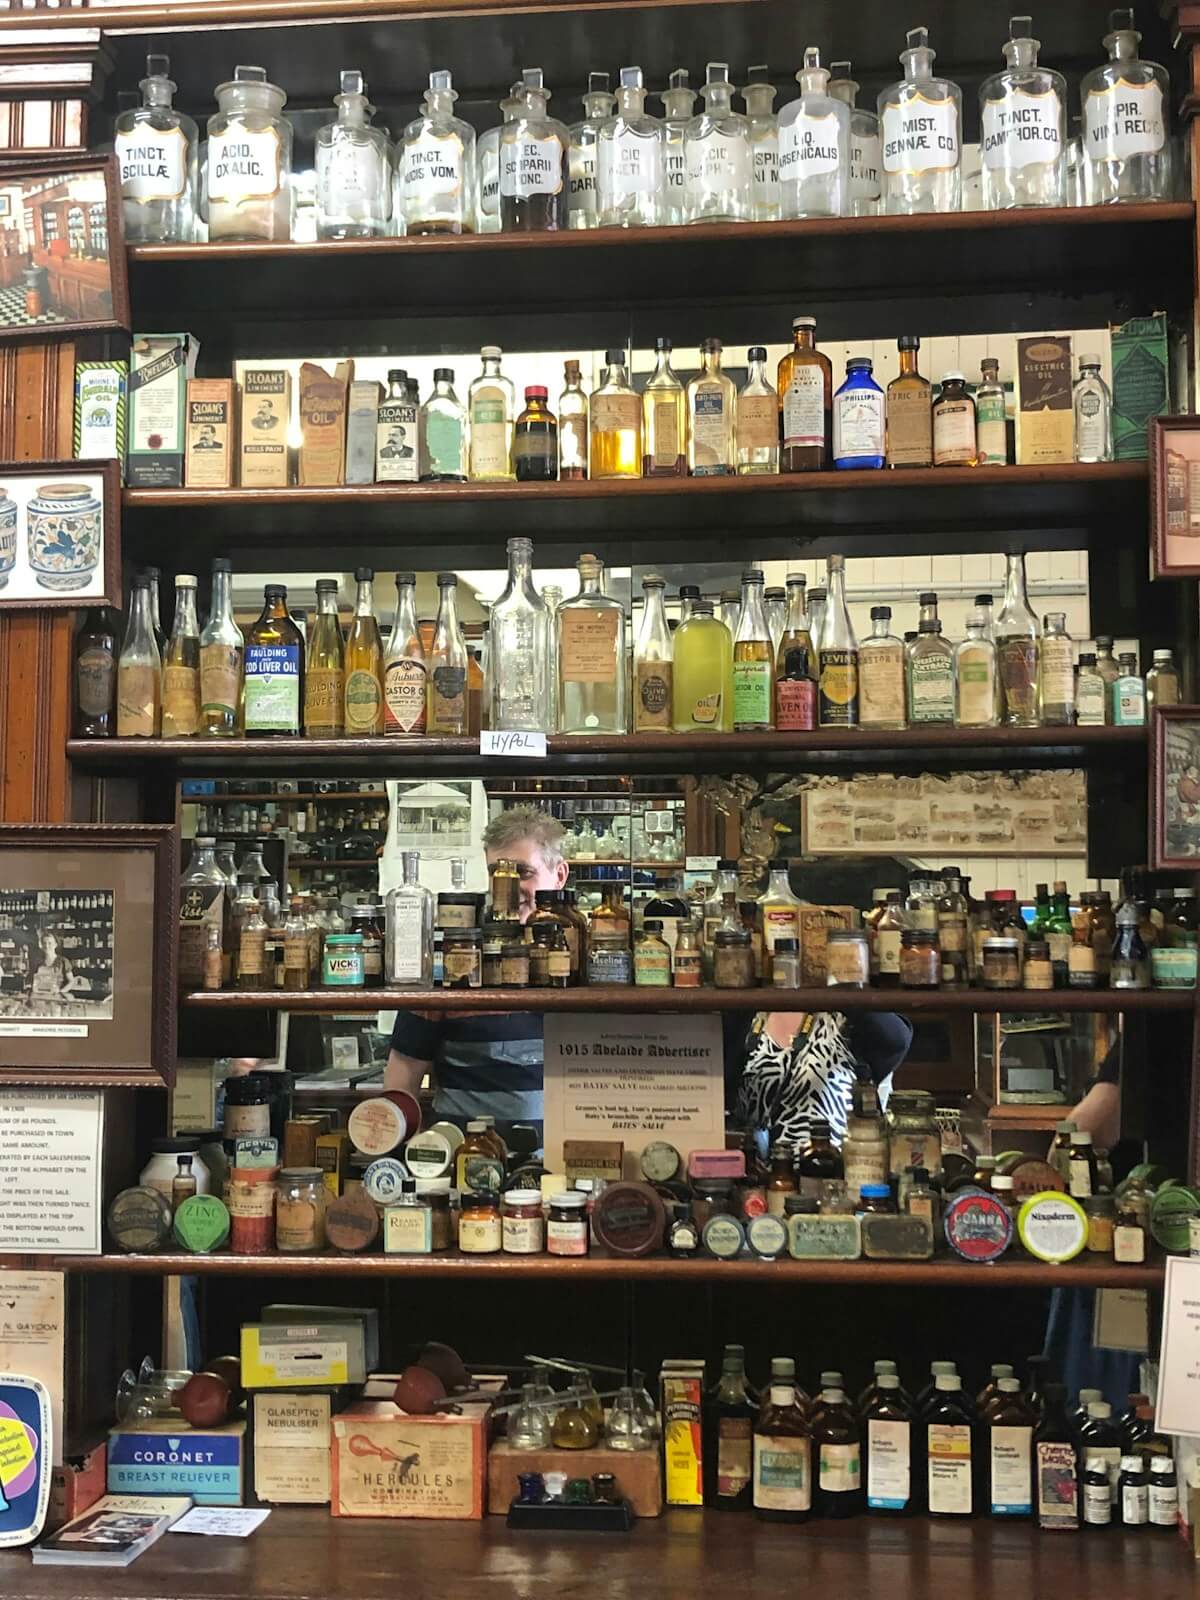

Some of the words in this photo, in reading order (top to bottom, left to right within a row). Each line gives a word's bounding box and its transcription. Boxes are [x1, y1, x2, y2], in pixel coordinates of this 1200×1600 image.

[902, 117, 937, 133] MIST.
[937, 135, 956, 151] CO.
[126, 147, 167, 161] TINCT.
[221, 145, 254, 158] ACID.
[216, 163, 263, 178] OXALIC.
[430, 166, 458, 180] VOM.
[1024, 362, 1065, 372] ELECTRIC
[247, 373, 284, 385] SLOAN'S
[1038, 371, 1053, 379] OIL
[192, 403, 224, 416] SLOAN'S
[378, 408, 414, 418] SLOAN'S
[311, 412, 331, 424] OIL
[250, 648, 288, 658] FAULDING
[258, 661, 282, 673] LIVER
[283, 661, 297, 672] OIL
[329, 958, 359, 972] VICKS
[559, 1043, 588, 1056] 1915
[593, 1042, 643, 1057] Adelaide
[648, 1043, 712, 1057] Advertiser
[267, 1419, 319, 1428] NEBULISER
[133, 1450, 215, 1463] CORONET
[118, 1471, 166, 1482] BREAST
[170, 1472, 232, 1484] RELIEVER
[363, 1472, 454, 1487] HERCULES
